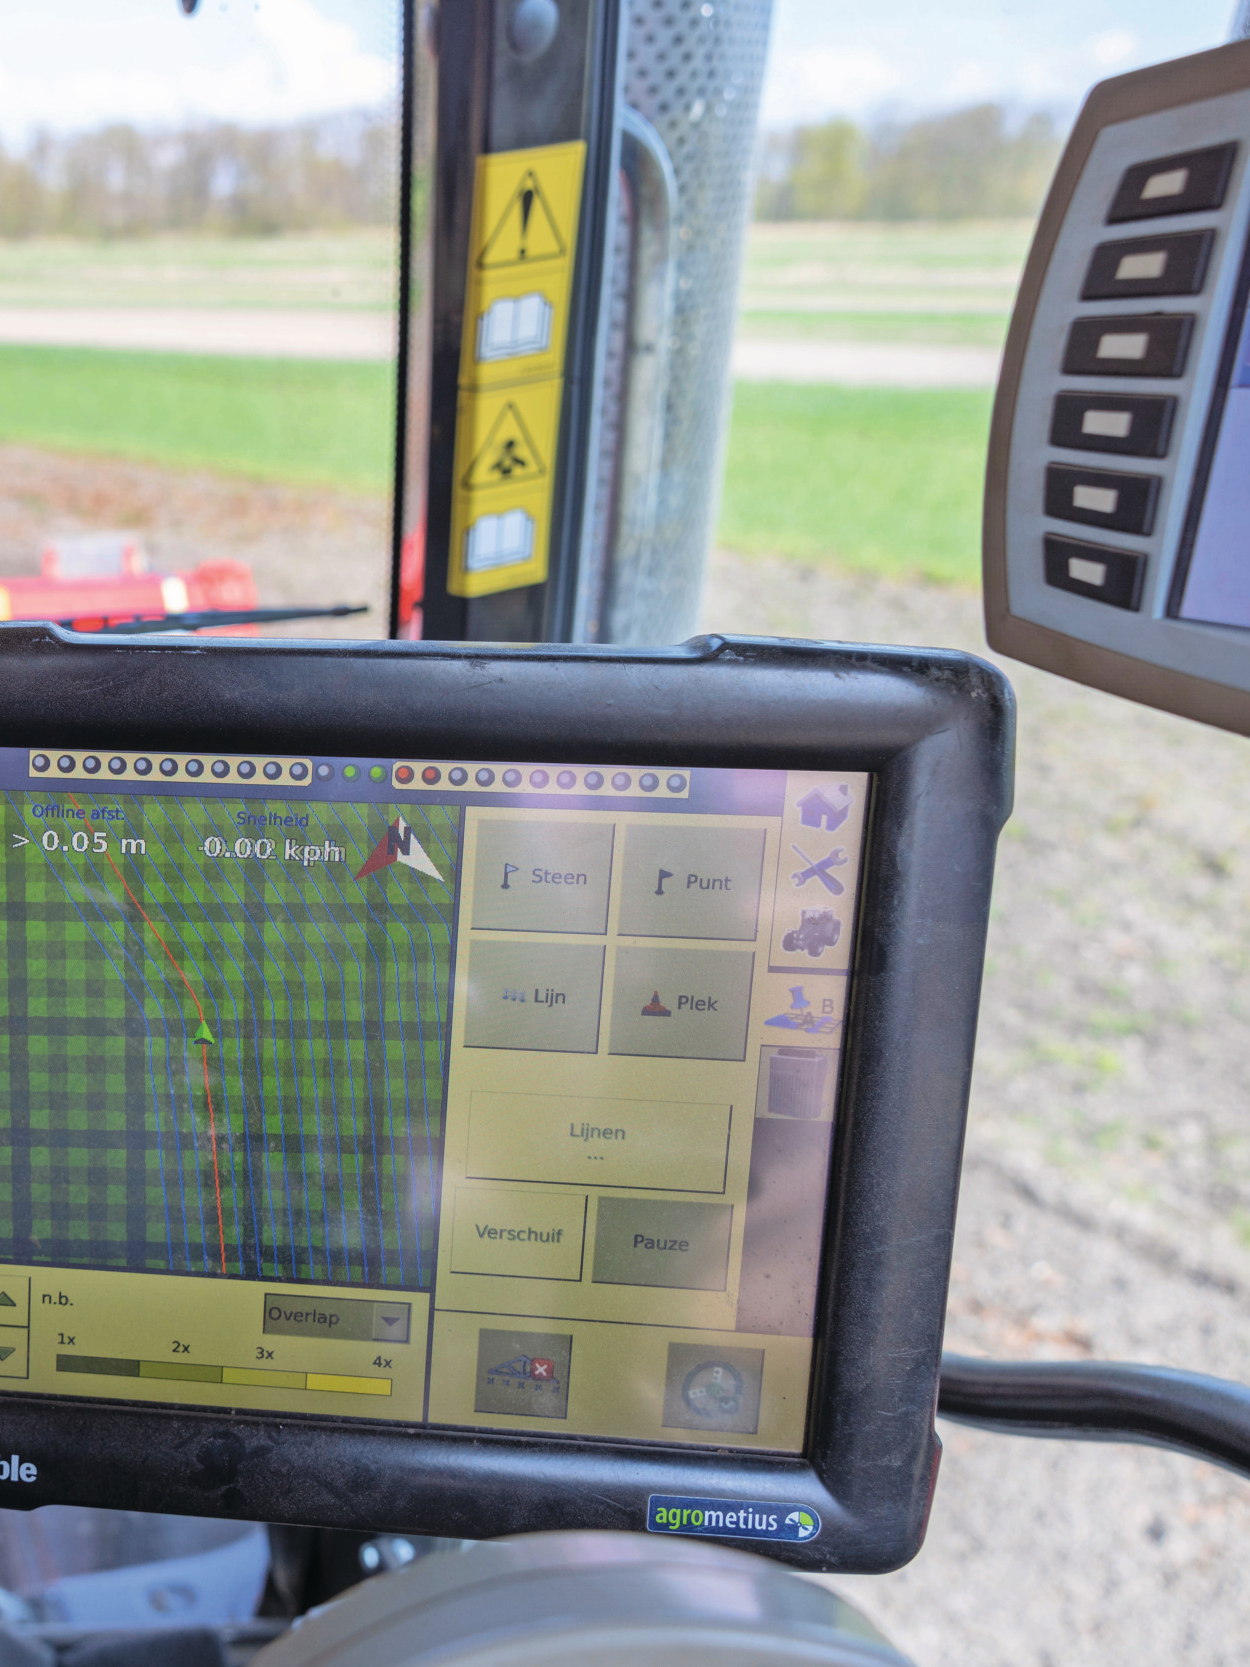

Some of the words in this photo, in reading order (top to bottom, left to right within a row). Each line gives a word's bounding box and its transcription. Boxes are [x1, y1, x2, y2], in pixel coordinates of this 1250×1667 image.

[31, 803, 86, 820] Offline
[90, 805, 126, 821] afst.
[236, 811, 310, 828] Snelheid
[41, 829, 109, 854] 0.05
[120, 837, 147, 855] m
[284, 838, 347, 868] kph
[530, 867, 588, 886] Steen
[686, 874, 733, 892] Punt
[534, 988, 567, 1008] Lijn
[677, 995, 719, 1013] Plek
[569, 1122, 626, 1141] Lijnen
[475, 1223, 564, 1244] Verschuif
[633, 1233, 690, 1253] Pauze
[41, 1291, 75, 1307] n.b.
[268, 1306, 341, 1328] Overlap
[57, 1333, 77, 1346] 1x
[171, 1341, 191, 1354] 2x
[255, 1347, 275, 1361] 3x
[372, 1356, 393, 1370] 4x
[655, 1507, 778, 1531] agrometius
